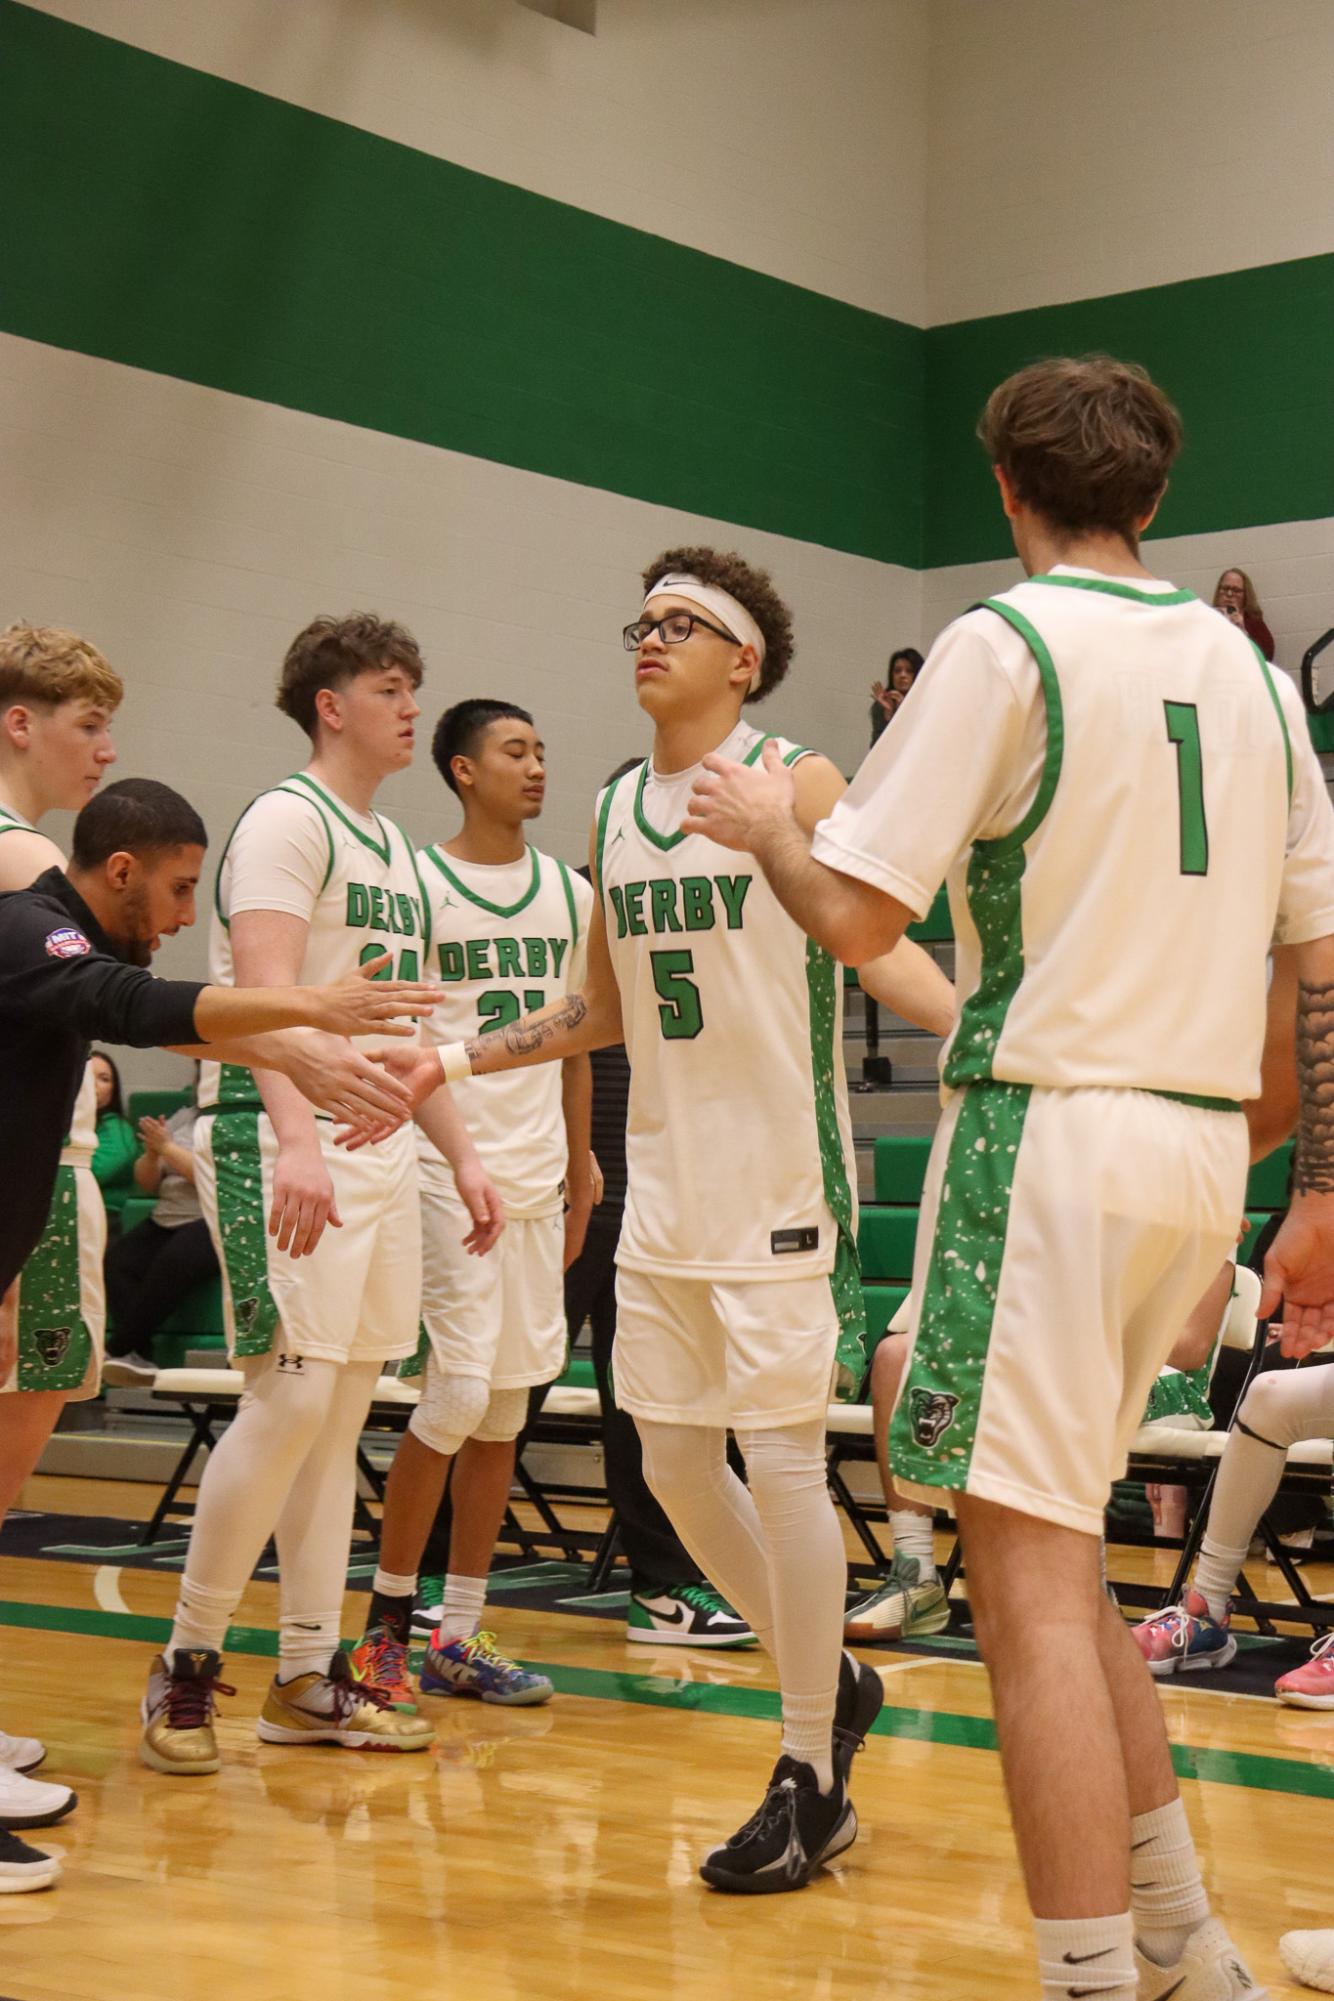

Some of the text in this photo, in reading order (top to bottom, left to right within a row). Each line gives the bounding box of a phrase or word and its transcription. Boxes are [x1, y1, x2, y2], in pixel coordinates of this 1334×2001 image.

[1163, 699, 1208, 876] 1
[609, 875, 752, 938] DERBY
[437, 937, 568, 981] DERBY
[477, 990, 545, 1035] 2
[649, 949, 704, 1040] 5
